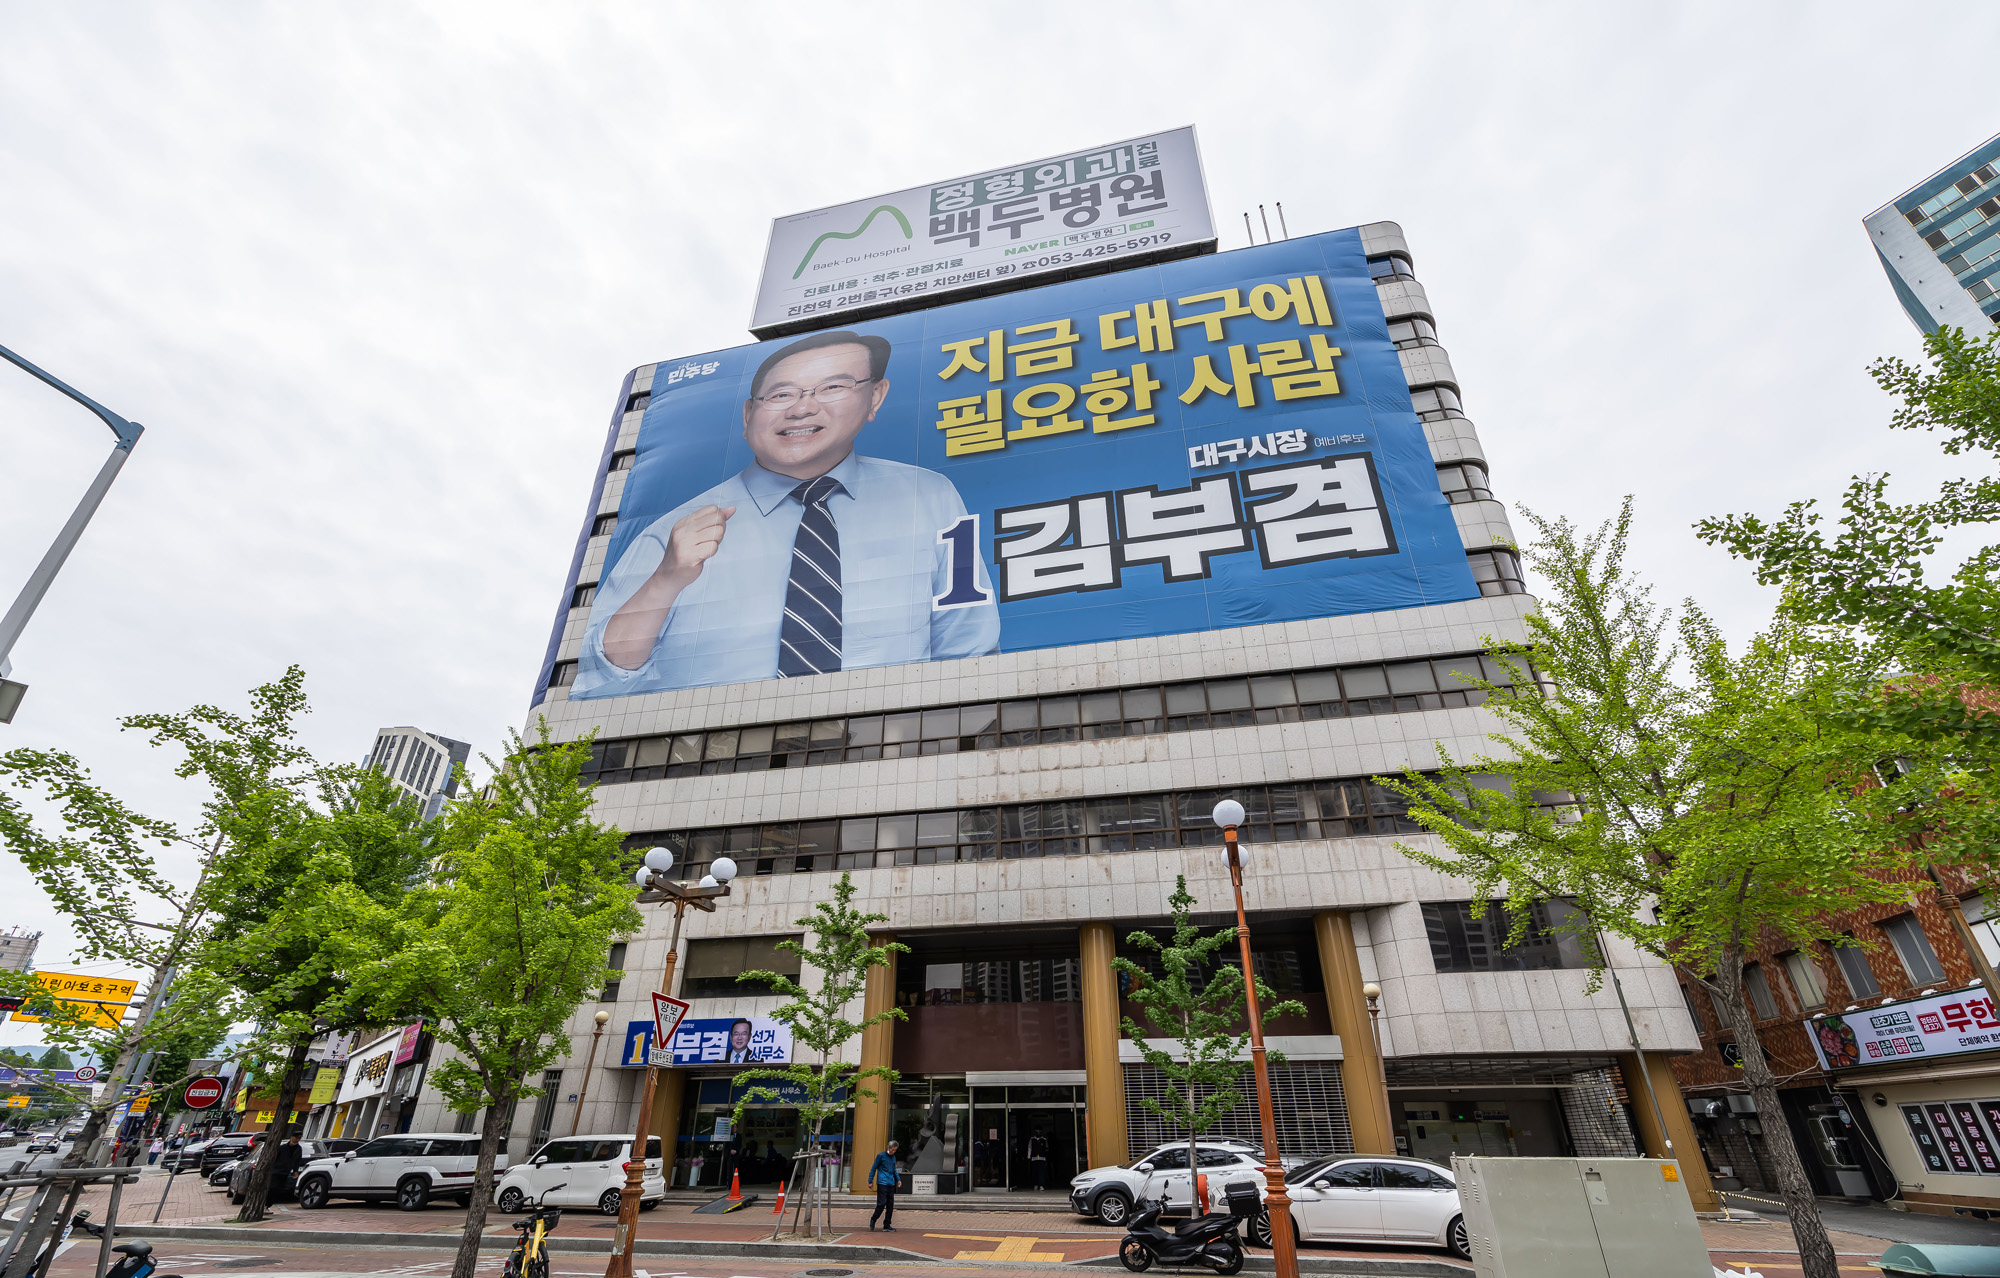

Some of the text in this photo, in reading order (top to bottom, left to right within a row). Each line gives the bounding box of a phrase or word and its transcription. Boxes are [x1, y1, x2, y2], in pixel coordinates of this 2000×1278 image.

[1136, 141, 1161, 170] 진료
[935, 149, 1132, 211] 정형외과
[928, 170, 1169, 248] 백두병원
[813, 244, 911, 271] Baek-Du Hospital
[1004, 239, 1059, 257] NAVER
[787, 301, 832, 317] 진천역
[933, 268, 990, 287] 치안센터
[1039, 232, 1172, 267] 053-425-5919
[803, 279, 858, 298] 진료내용
[938, 275, 1334, 383] 지금 대구에
[667, 361, 721, 384] 민주당
[936, 333, 1342, 457] 필요한 사람
[1188, 429, 1366, 468] 대구시장 예비후보
[932, 453, 1398, 612] 1 김부겸
[660, 1013, 677, 1024] YIELD
[661, 1001, 678, 1016] 양보
[1893, 1012, 1910, 1024] 만든
[628, 1031, 729, 1064] 1 부겸
[752, 1030, 775, 1043] 선거
[1958, 1035, 1990, 1047] 단체예약
[750, 1046, 785, 1060] 사무소
[79, 1069, 92, 1078] 50
[190, 1089, 217, 1097] 진입금지
[781, 1087, 800, 1095] 사무소
[1934, 1112, 1968, 1168] 대패삼겹
[1960, 1111, 1996, 1169] 냉동삼겹
